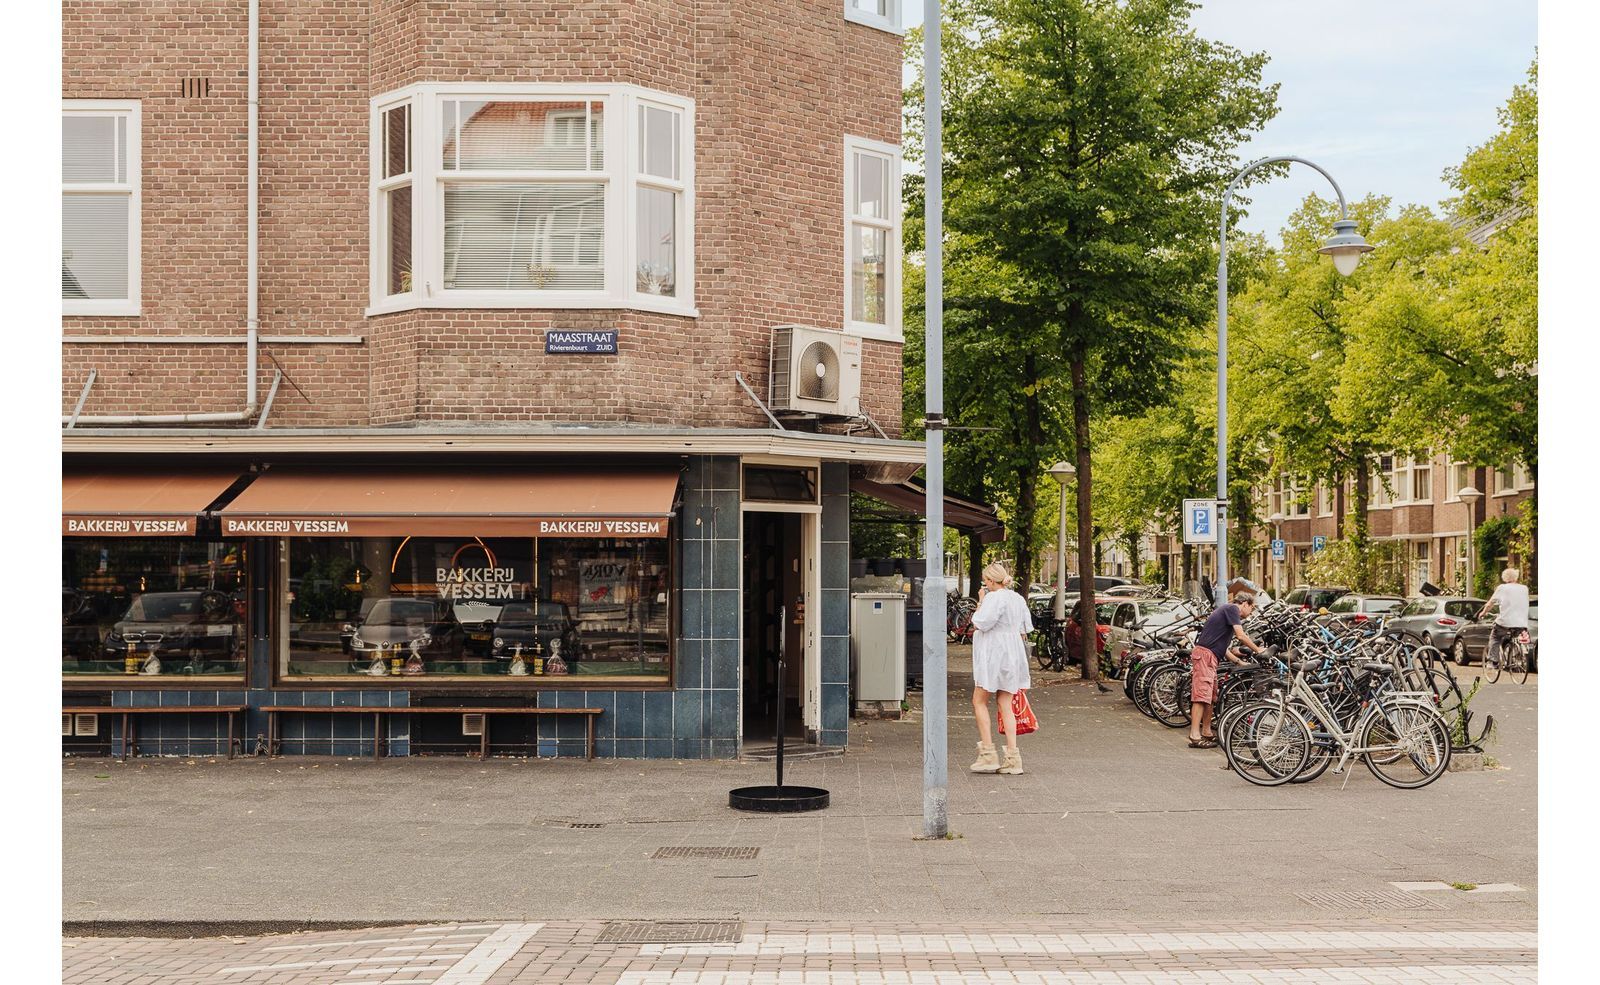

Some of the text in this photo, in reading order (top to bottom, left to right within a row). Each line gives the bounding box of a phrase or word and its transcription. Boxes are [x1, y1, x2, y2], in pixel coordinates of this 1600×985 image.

[549, 333, 613, 343] MAASSTRAAT
[1196, 510, 1206, 524] P
[68, 520, 187, 532] BAKKERIJ VESSEM
[228, 520, 349, 533] BAKKERIJ VESSEM
[540, 521, 660, 533] BAKKERIJ VESSEM
[436, 567, 514, 583] BAKKERIJ
[439, 583, 514, 600] VESSEM
